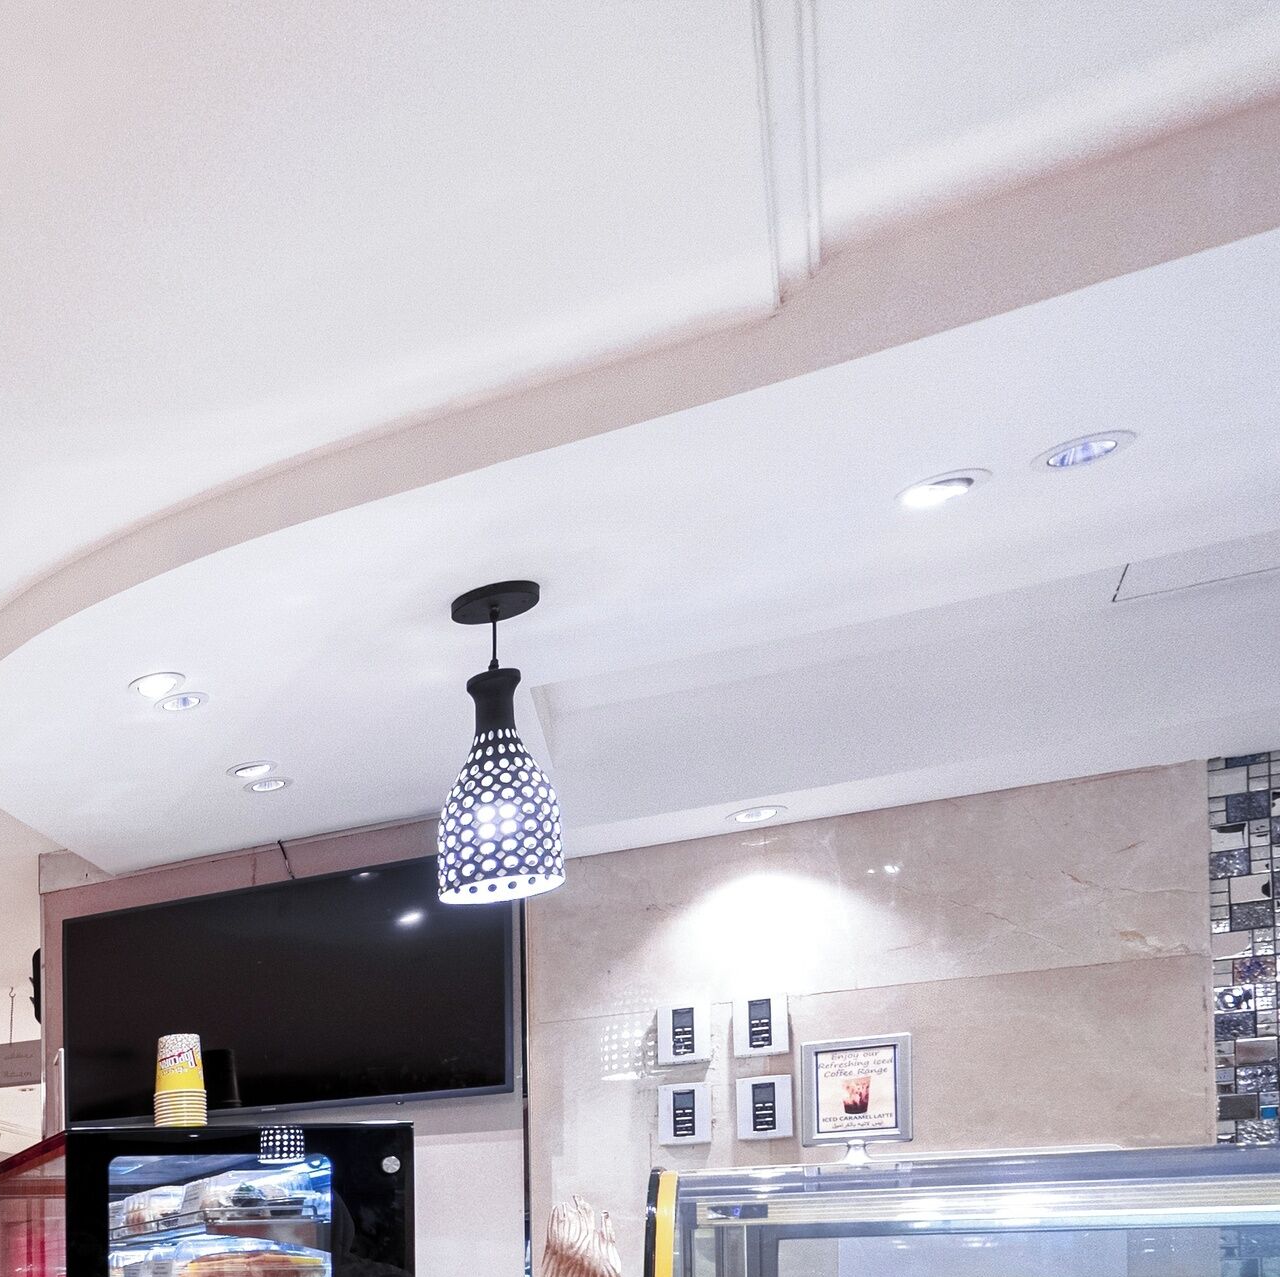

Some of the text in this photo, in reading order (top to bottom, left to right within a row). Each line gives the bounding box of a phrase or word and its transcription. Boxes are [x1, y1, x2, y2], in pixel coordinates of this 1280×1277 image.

[832, 1050, 880, 1062] Enjoy our
[818, 1060, 870, 1070] Refreshing
[824, 1067, 888, 1078] Coffee Range
[840, 1114, 873, 1122] CARAMEL
